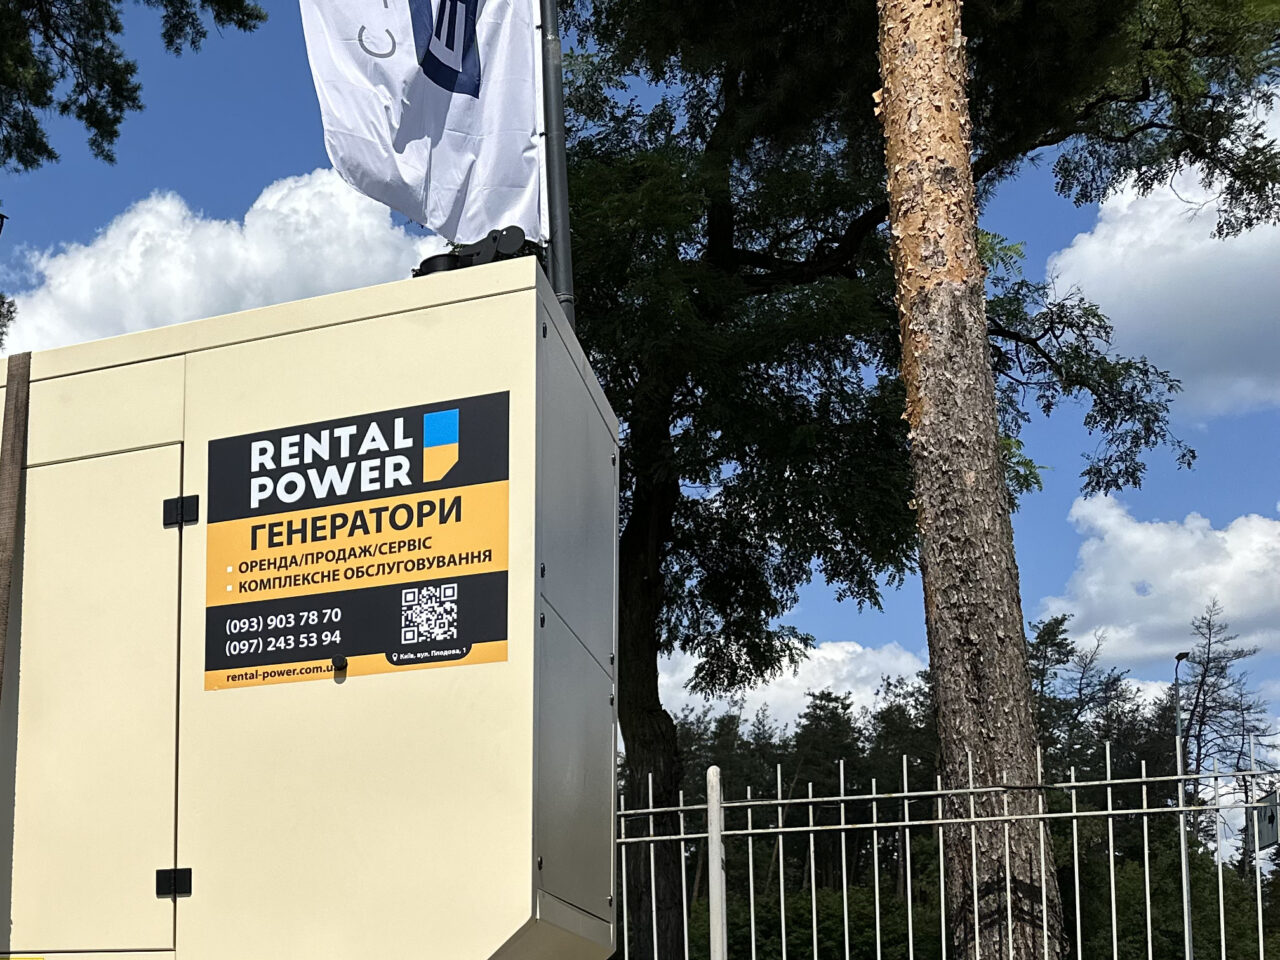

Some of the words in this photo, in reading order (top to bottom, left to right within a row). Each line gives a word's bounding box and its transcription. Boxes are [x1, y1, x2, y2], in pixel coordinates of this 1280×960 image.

[250, 417, 414, 473] RENTAL
[250, 455, 412, 509] POWER
[250, 495, 462, 550] ГЕНЕРАТОРИ
[238, 536, 432, 574] ОРЕНДА/ПРОДАЖ/СЕРВІС
[238, 570, 341, 594] КОМПЛЕКСНЕ
[343, 549, 493, 580] ОБСЛУГОВУВАННЯ
[226, 616, 263, 635] (093)
[266, 613, 295, 630] 903
[299, 610, 319, 626] 78
[322, 607, 342, 623] 70
[225, 637, 263, 657] (097)
[266, 635, 295, 651] 243
[298, 632, 318, 648] 53
[321, 629, 341, 645] 94
[226, 665, 335, 682] rental-power.com.u
